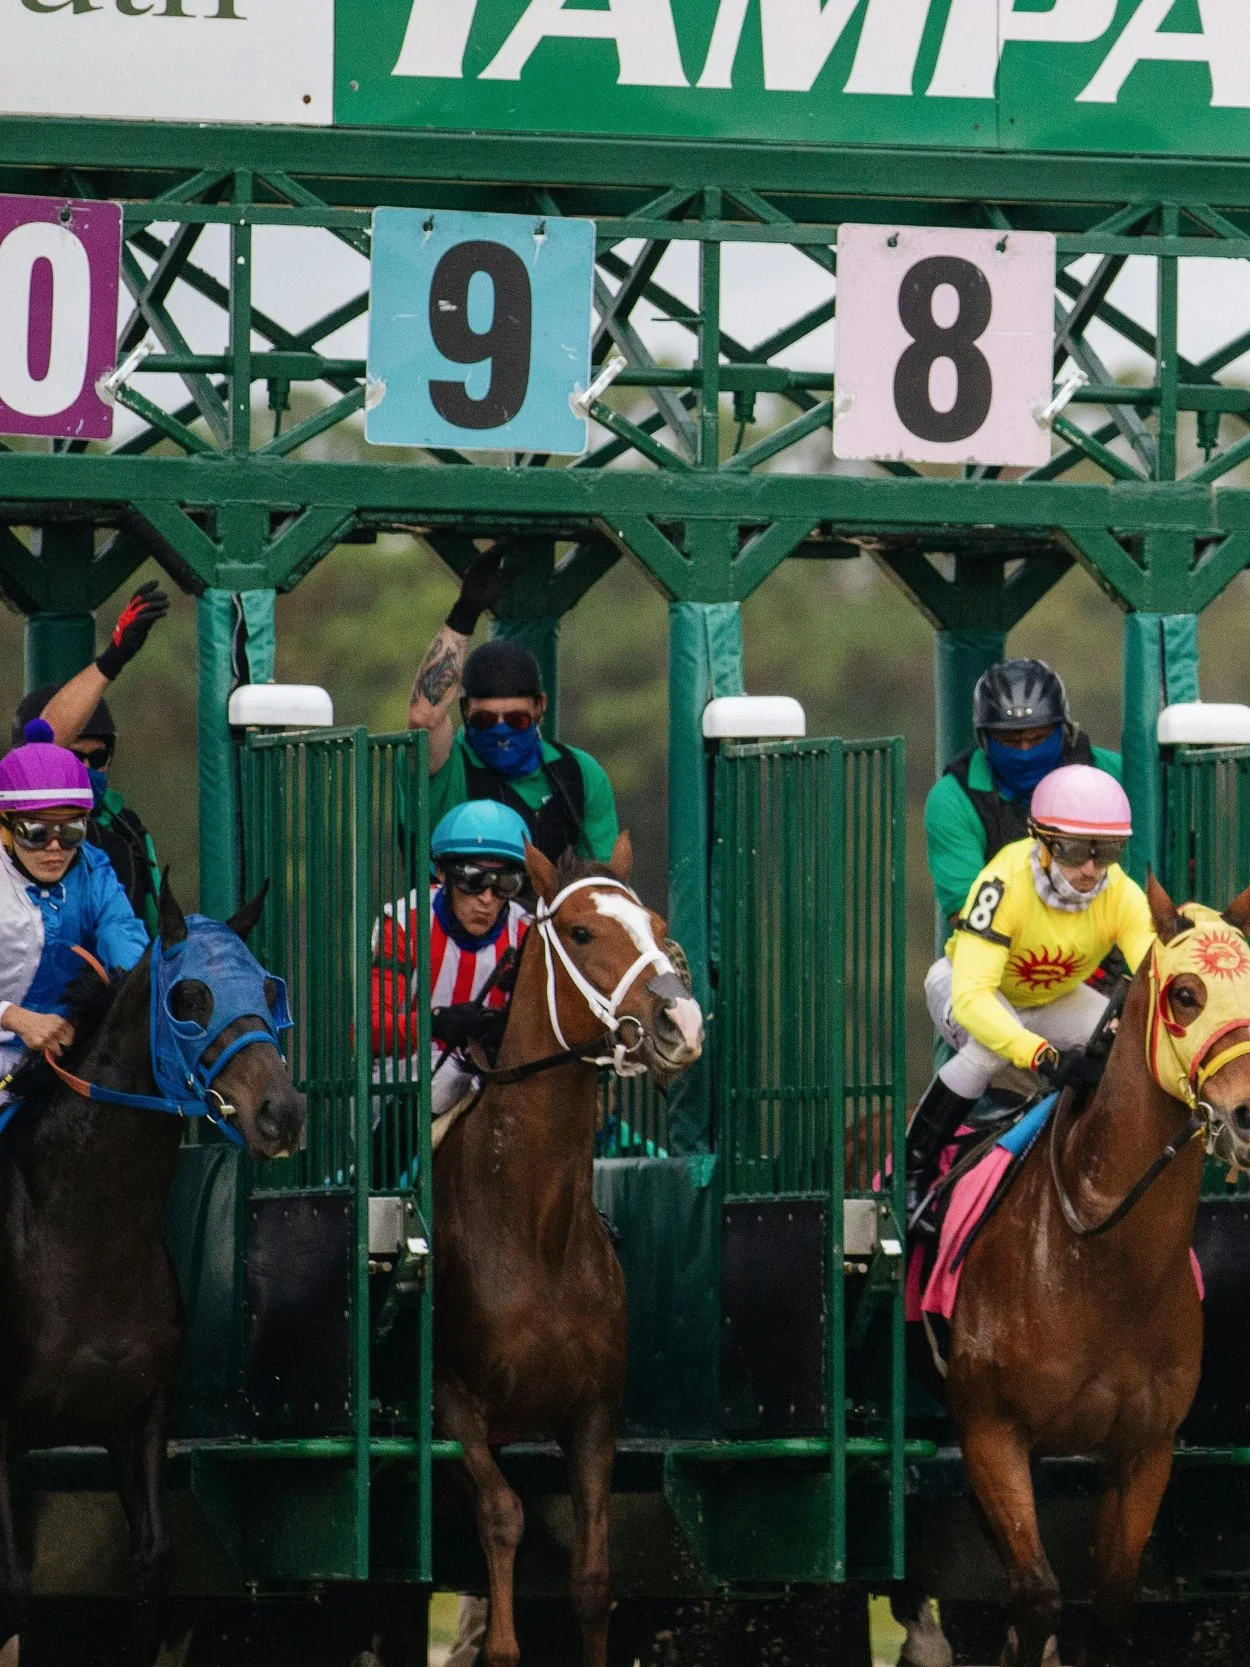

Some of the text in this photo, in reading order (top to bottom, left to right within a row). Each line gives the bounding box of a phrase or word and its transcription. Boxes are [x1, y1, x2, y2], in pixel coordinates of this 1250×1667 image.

[427, 240, 533, 430] 9
[893, 255, 993, 443] 8
[969, 886, 1000, 930] 8
